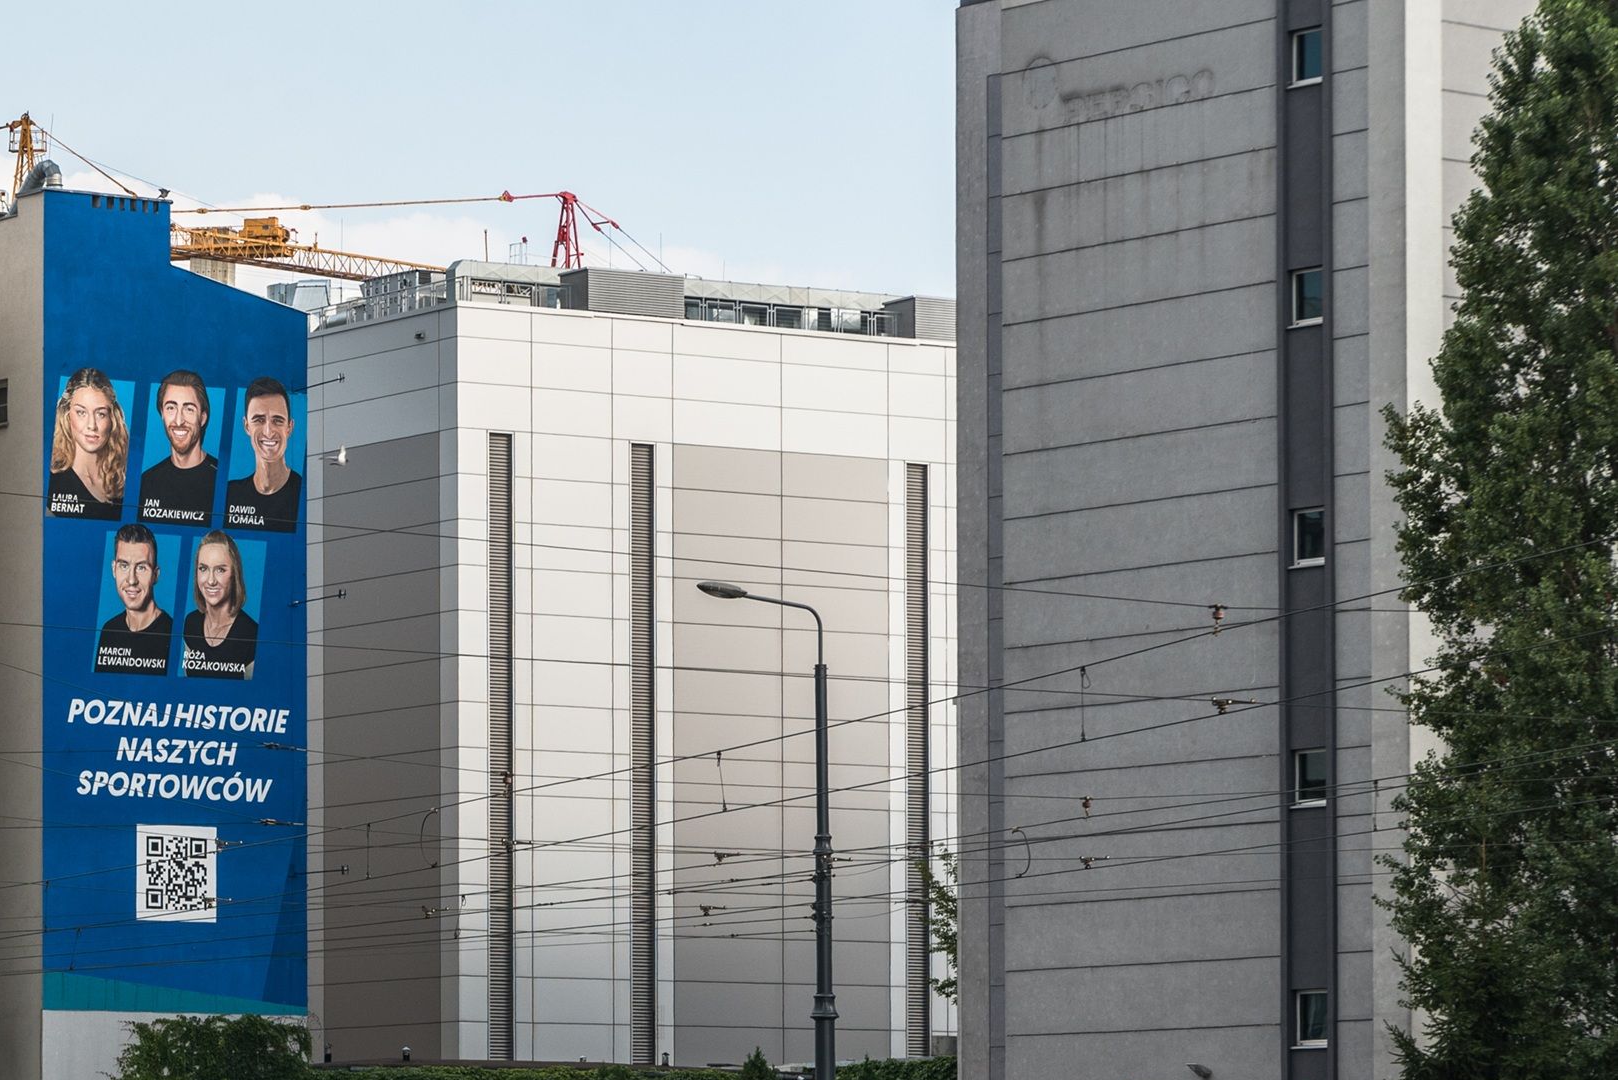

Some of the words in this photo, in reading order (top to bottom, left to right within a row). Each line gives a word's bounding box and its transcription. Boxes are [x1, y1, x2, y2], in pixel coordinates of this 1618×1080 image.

[52, 493, 79, 503] LAURA
[144, 498, 160, 508] JAN
[50, 503, 85, 514] BERNAT
[142, 508, 205, 521] KOZAKIEWICZ
[229, 504, 256, 515] DAWID
[228, 514, 265, 526] TOMALA
[99, 647, 132, 657] MARCIN
[183, 649, 206, 660] RÓŻA
[97, 656, 166, 669] LEWANDOWSKI
[182, 659, 247, 673] KOZAKOWSKA
[67, 698, 172, 728] POZNAJ
[173, 703, 290, 734] HISTORIE
[116, 736, 238, 767] NASZYCH
[76, 769, 273, 803] SPORTOWCÓW
